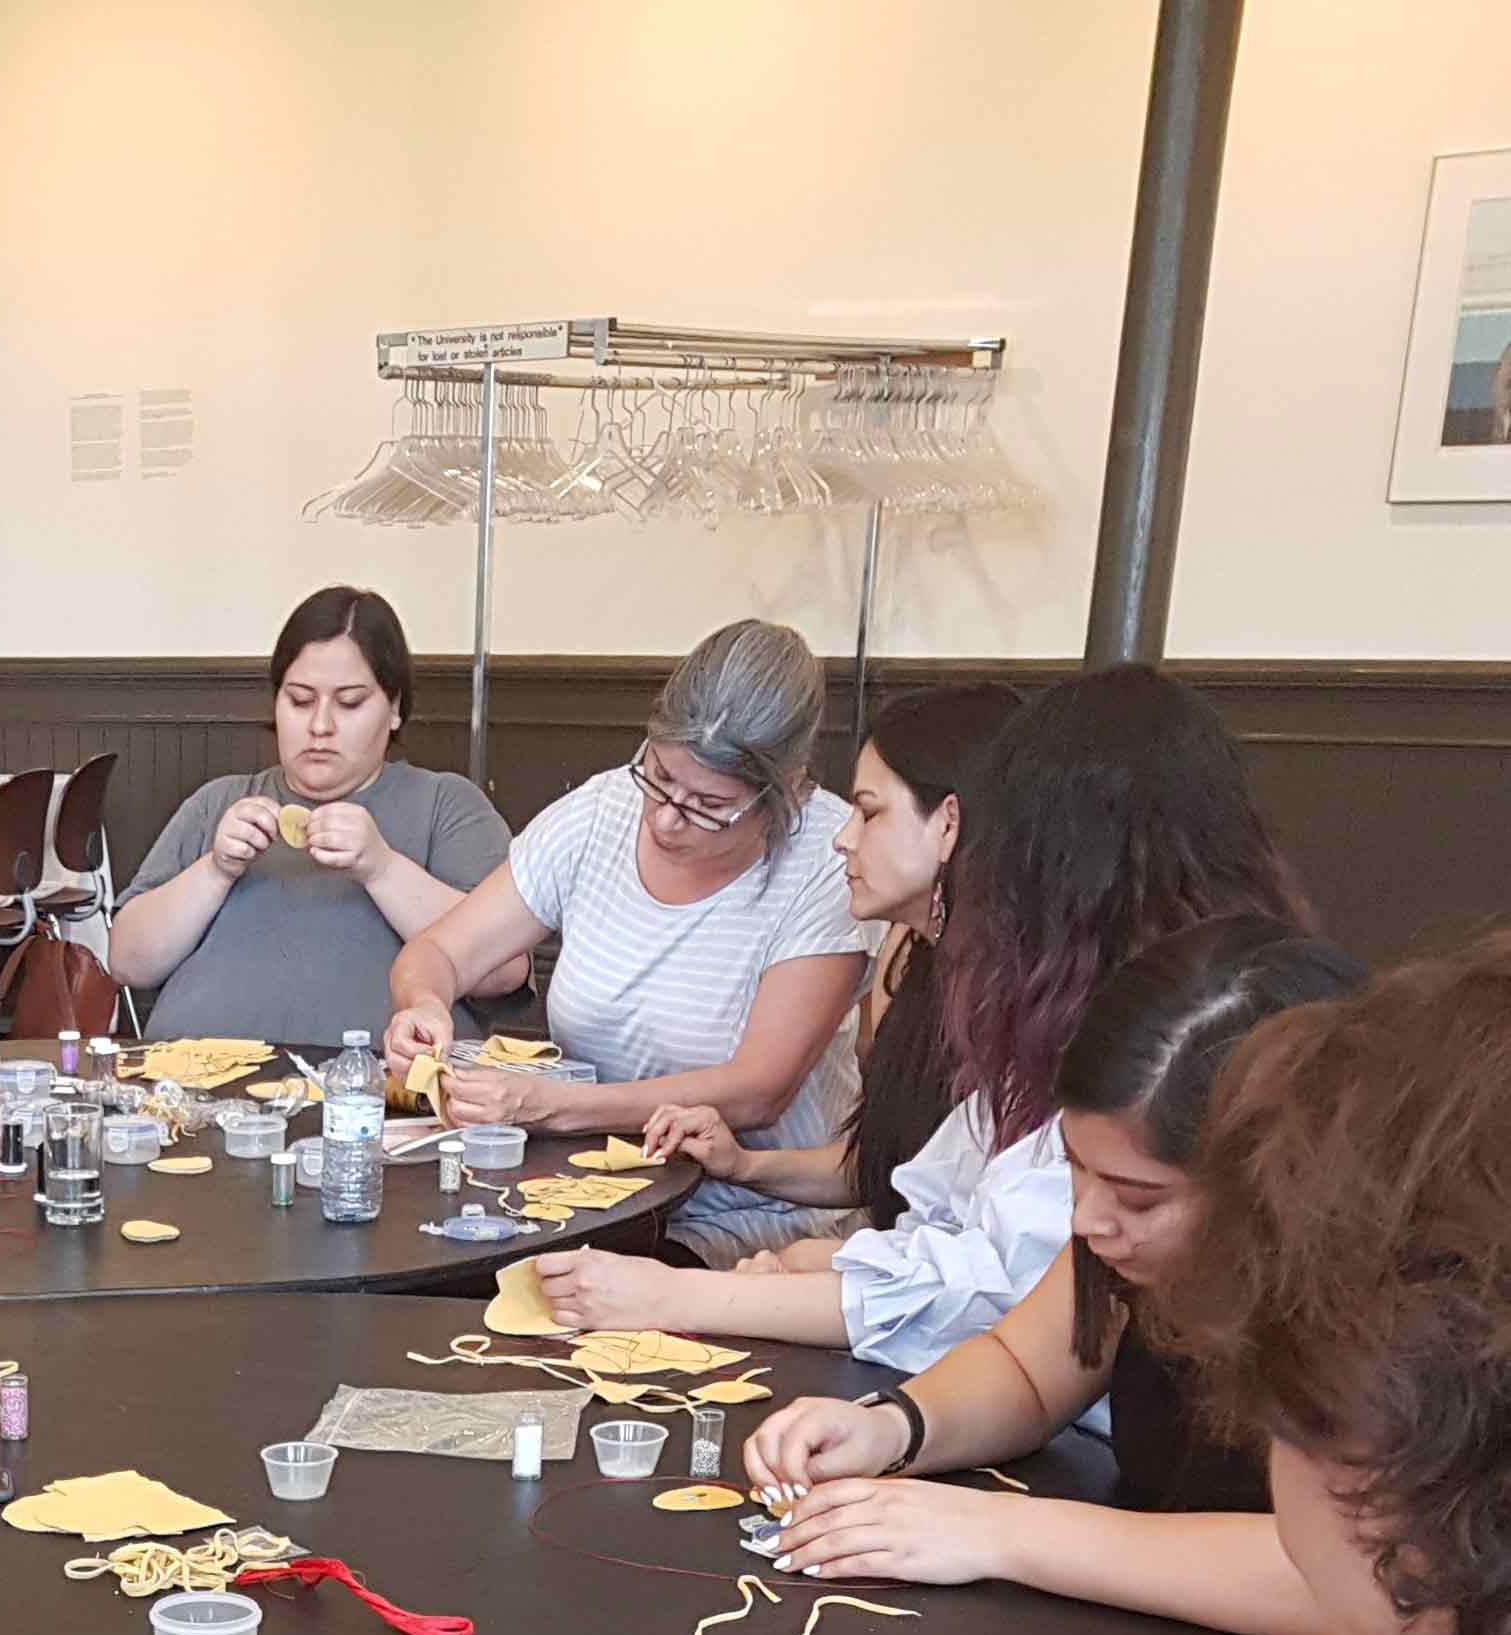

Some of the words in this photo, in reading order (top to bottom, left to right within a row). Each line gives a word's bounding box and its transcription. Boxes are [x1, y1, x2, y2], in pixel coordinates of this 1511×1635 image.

[417, 335, 432, 346] The
[436, 332, 474, 345] University
[479, 332, 486, 342] is
[490, 331, 504, 342] not
[507, 326, 557, 341] responsible
[492, 346, 522, 358] articles
